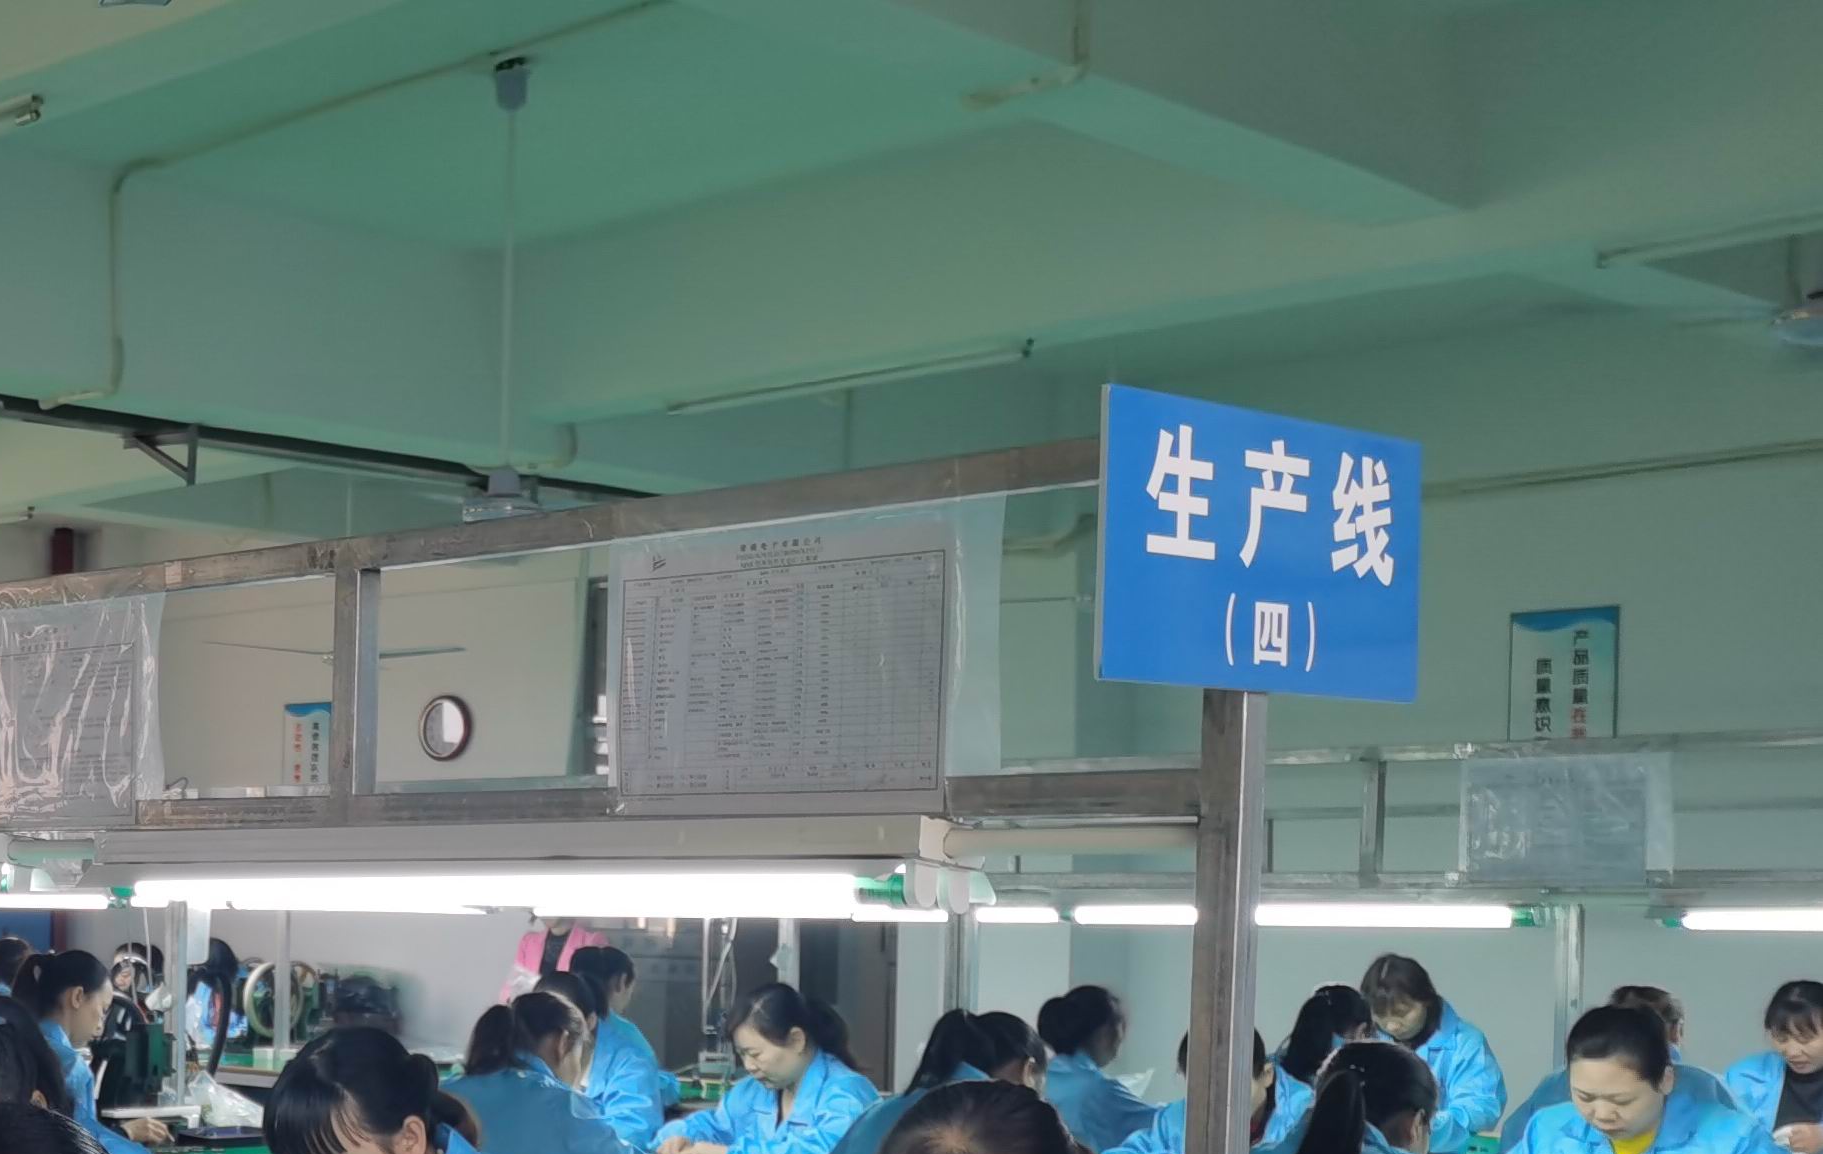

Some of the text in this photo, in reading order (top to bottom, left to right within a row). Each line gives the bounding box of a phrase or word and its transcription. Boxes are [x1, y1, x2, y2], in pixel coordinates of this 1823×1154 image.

[1146, 424, 1394, 586] 生产线
[1225, 593, 1316, 673] （四）
[1534, 657, 1553, 740] 质量意识
